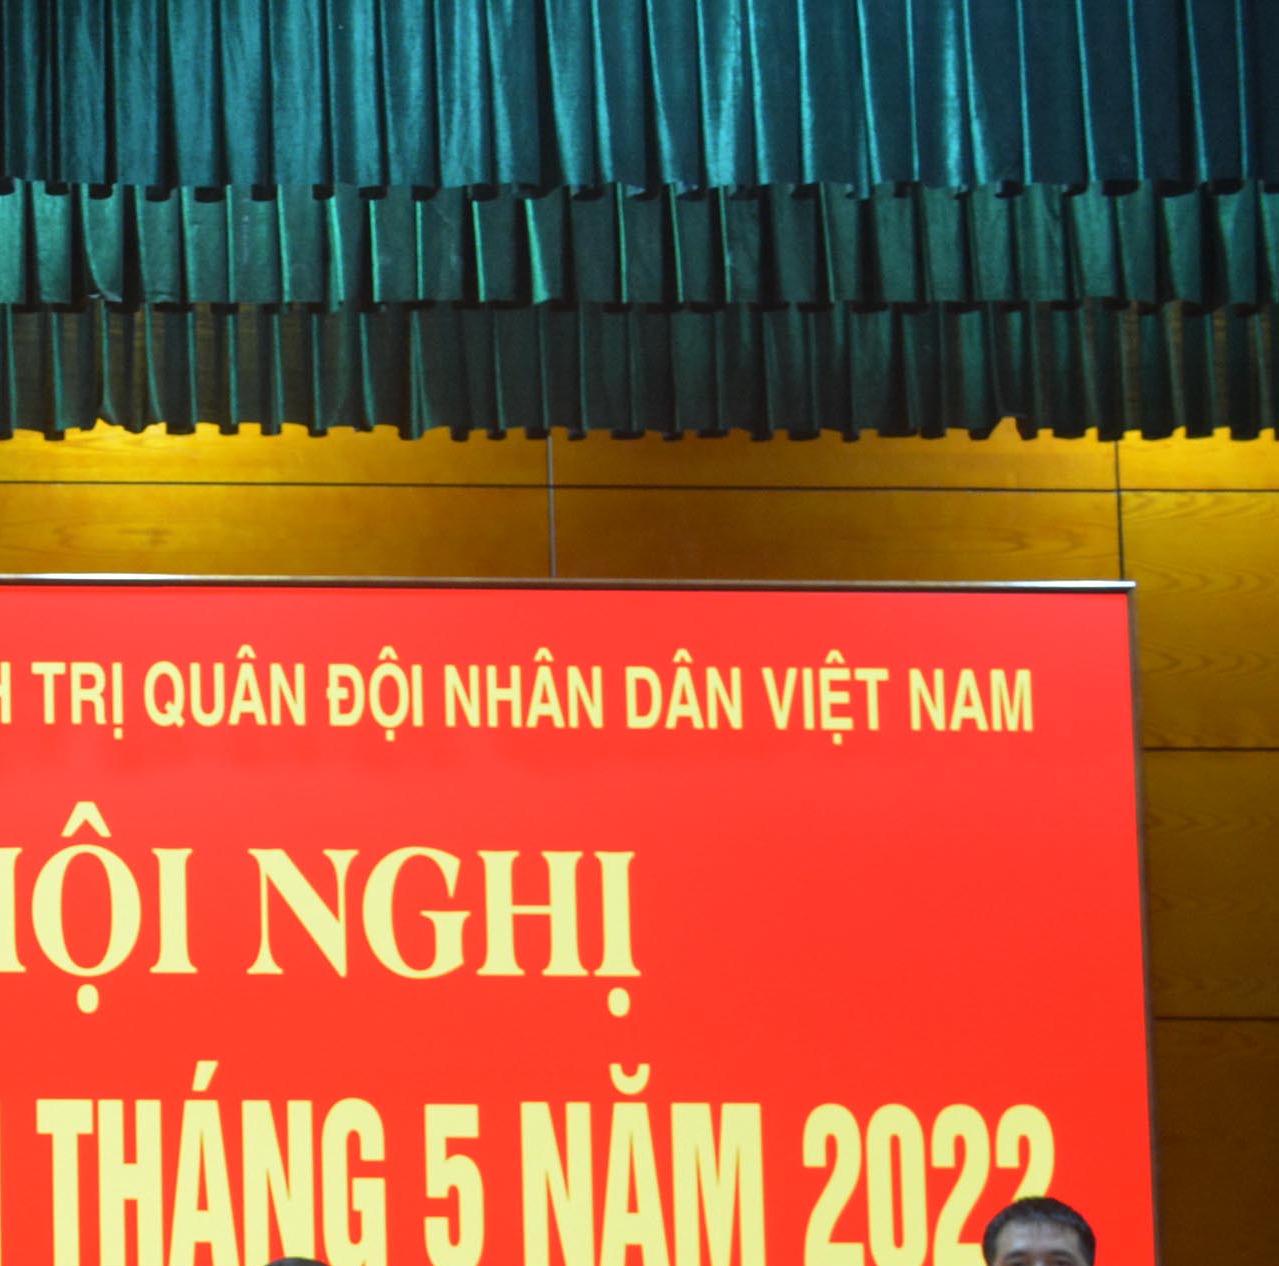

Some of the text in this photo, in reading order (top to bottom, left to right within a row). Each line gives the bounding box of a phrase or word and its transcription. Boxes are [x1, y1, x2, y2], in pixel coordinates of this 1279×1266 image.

[32, 662, 123, 739] TRỊ
[144, 645, 305, 727] QUÂN
[327, 646, 423, 741] ĐỘI
[445, 648, 603, 728] NHÂN
[626, 649, 742, 729] DÂN
[762, 650, 889, 745] VIỆT
[910, 669, 1033, 731] NAM
[247, 847, 641, 1016] NGHỊ
